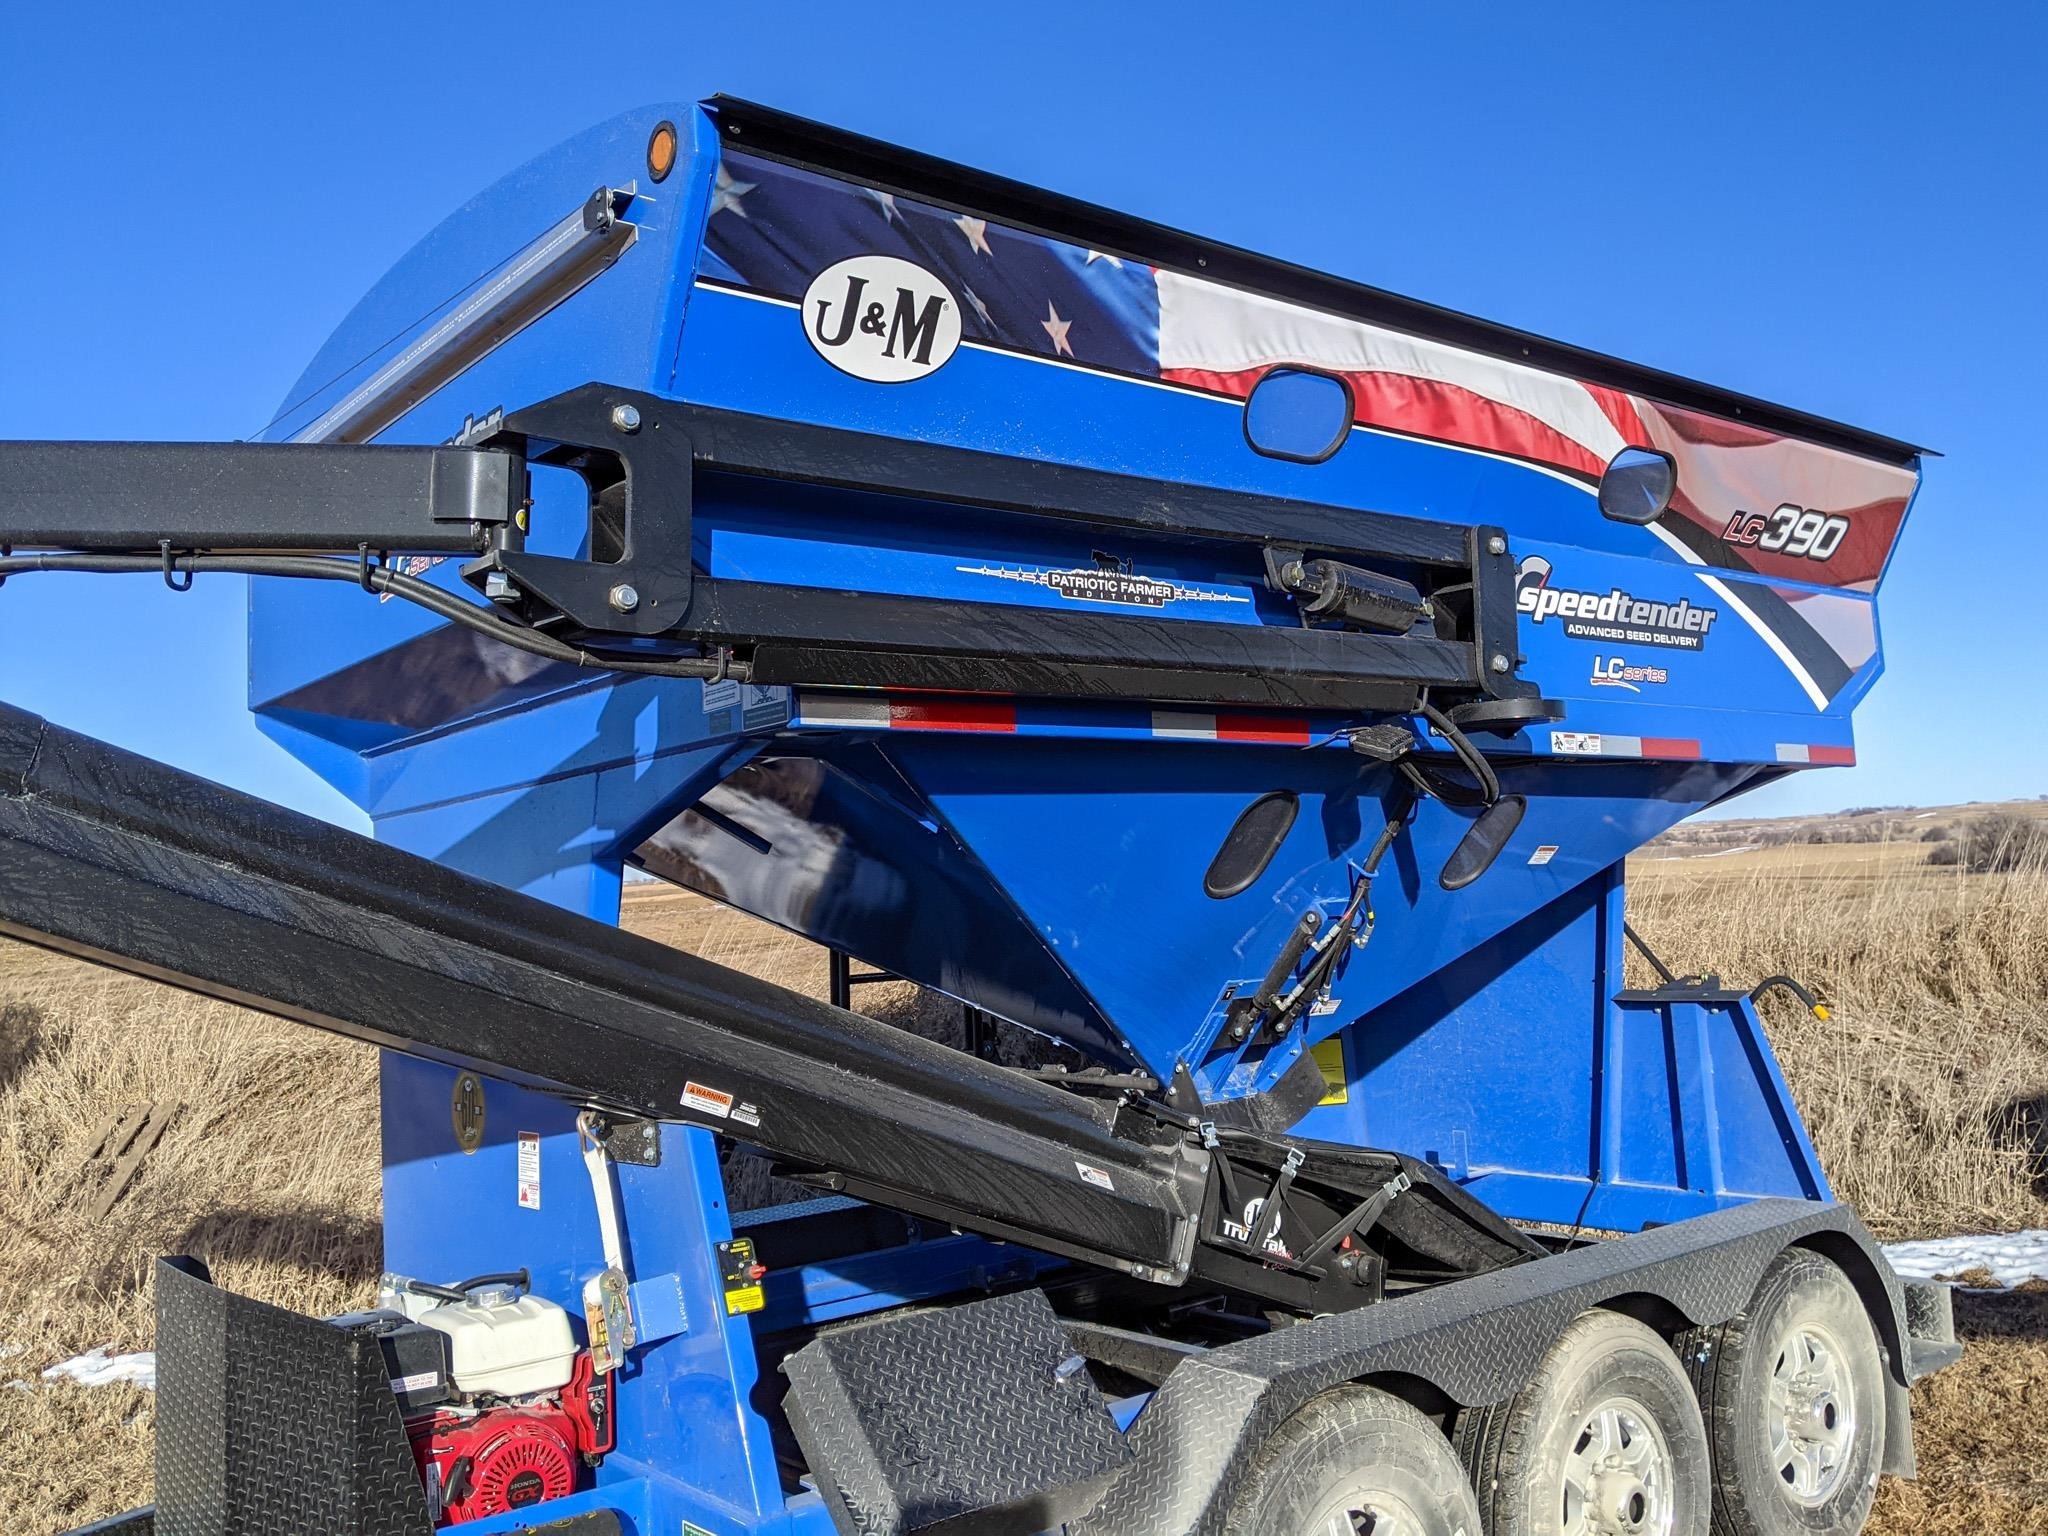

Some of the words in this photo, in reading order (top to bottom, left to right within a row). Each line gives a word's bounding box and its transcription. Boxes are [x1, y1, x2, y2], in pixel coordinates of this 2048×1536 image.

[816, 275, 946, 366] J&M
[1051, 574, 1118, 592] PATRIOTIC
[1120, 581, 1172, 598] FARMER
[1073, 589, 1155, 604] EDITION
[1567, 623, 1625, 640] ADVANCED
[1626, 629, 1651, 643] SEED
[1653, 633, 1699, 648] DELIVERY
[694, 1087, 728, 1105] WARNING
[510, 1477, 542, 1491] HONDA
